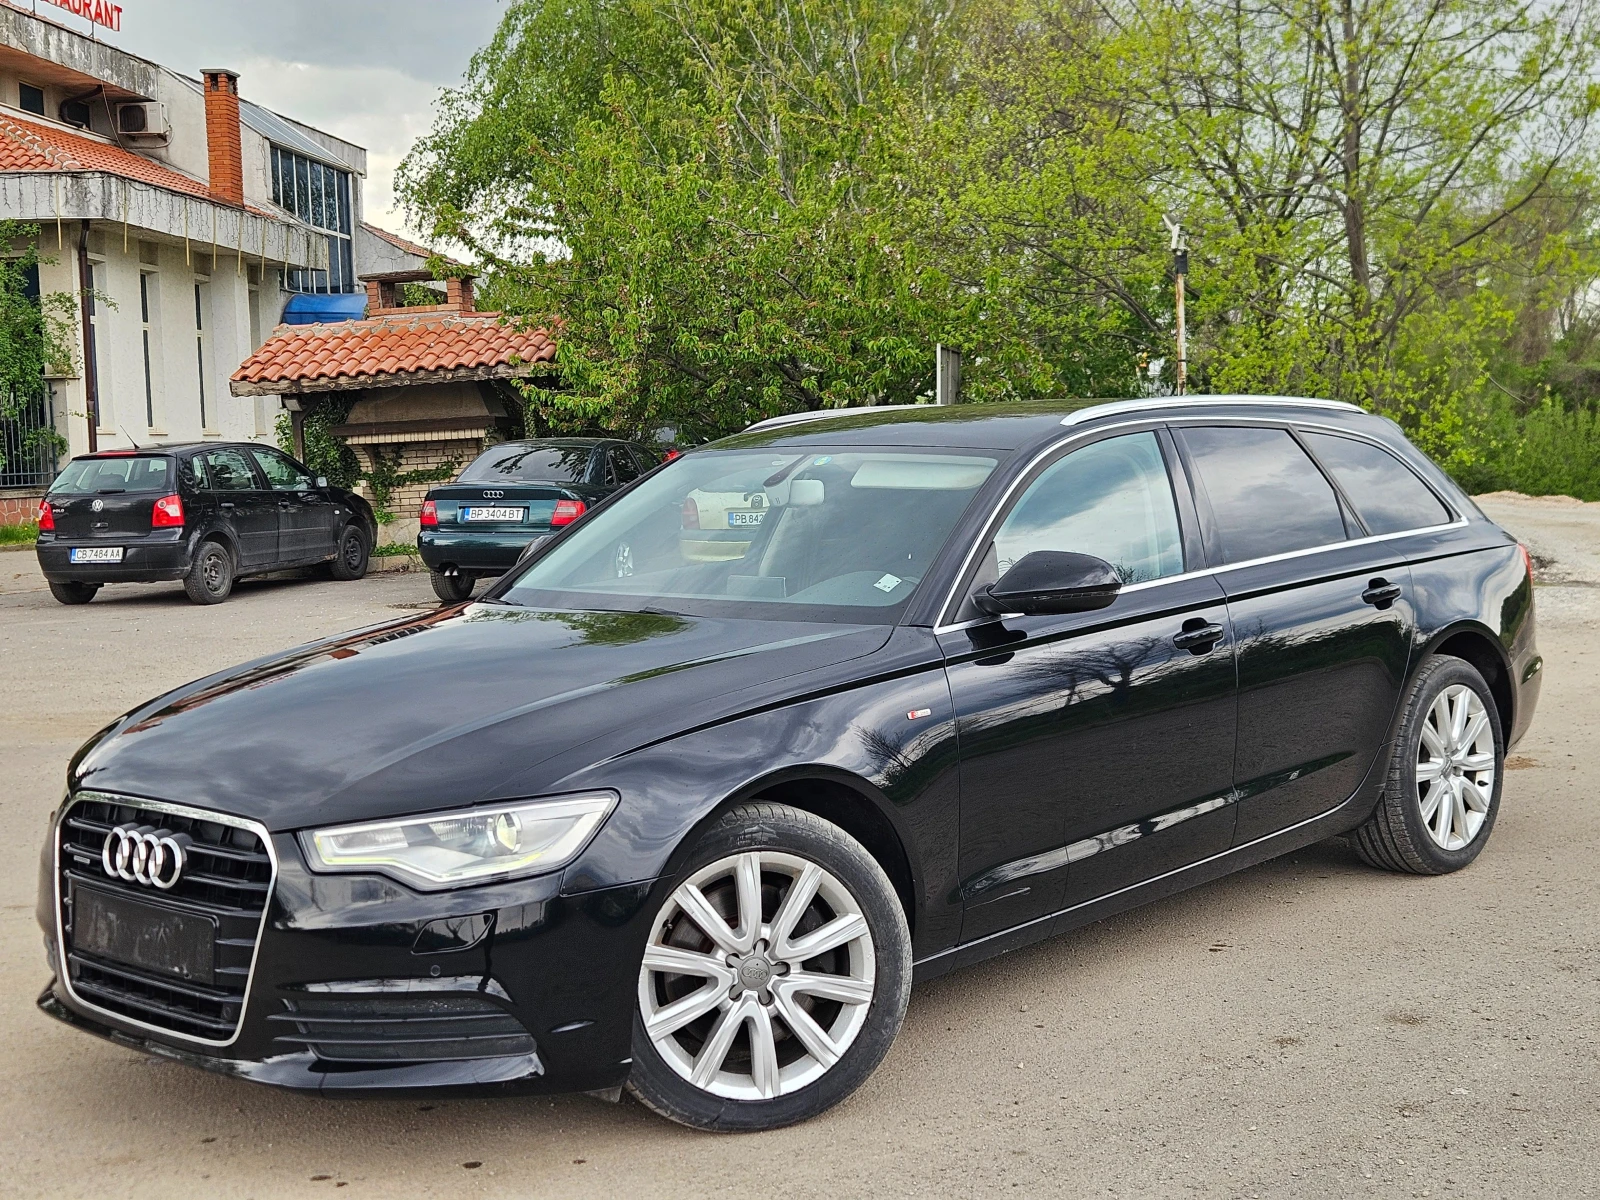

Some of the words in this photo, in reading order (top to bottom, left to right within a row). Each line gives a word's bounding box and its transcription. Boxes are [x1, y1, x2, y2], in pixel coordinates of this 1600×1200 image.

[470, 509, 484, 519] BP
[484, 509, 507, 519] 3404
[508, 509, 522, 519] BT
